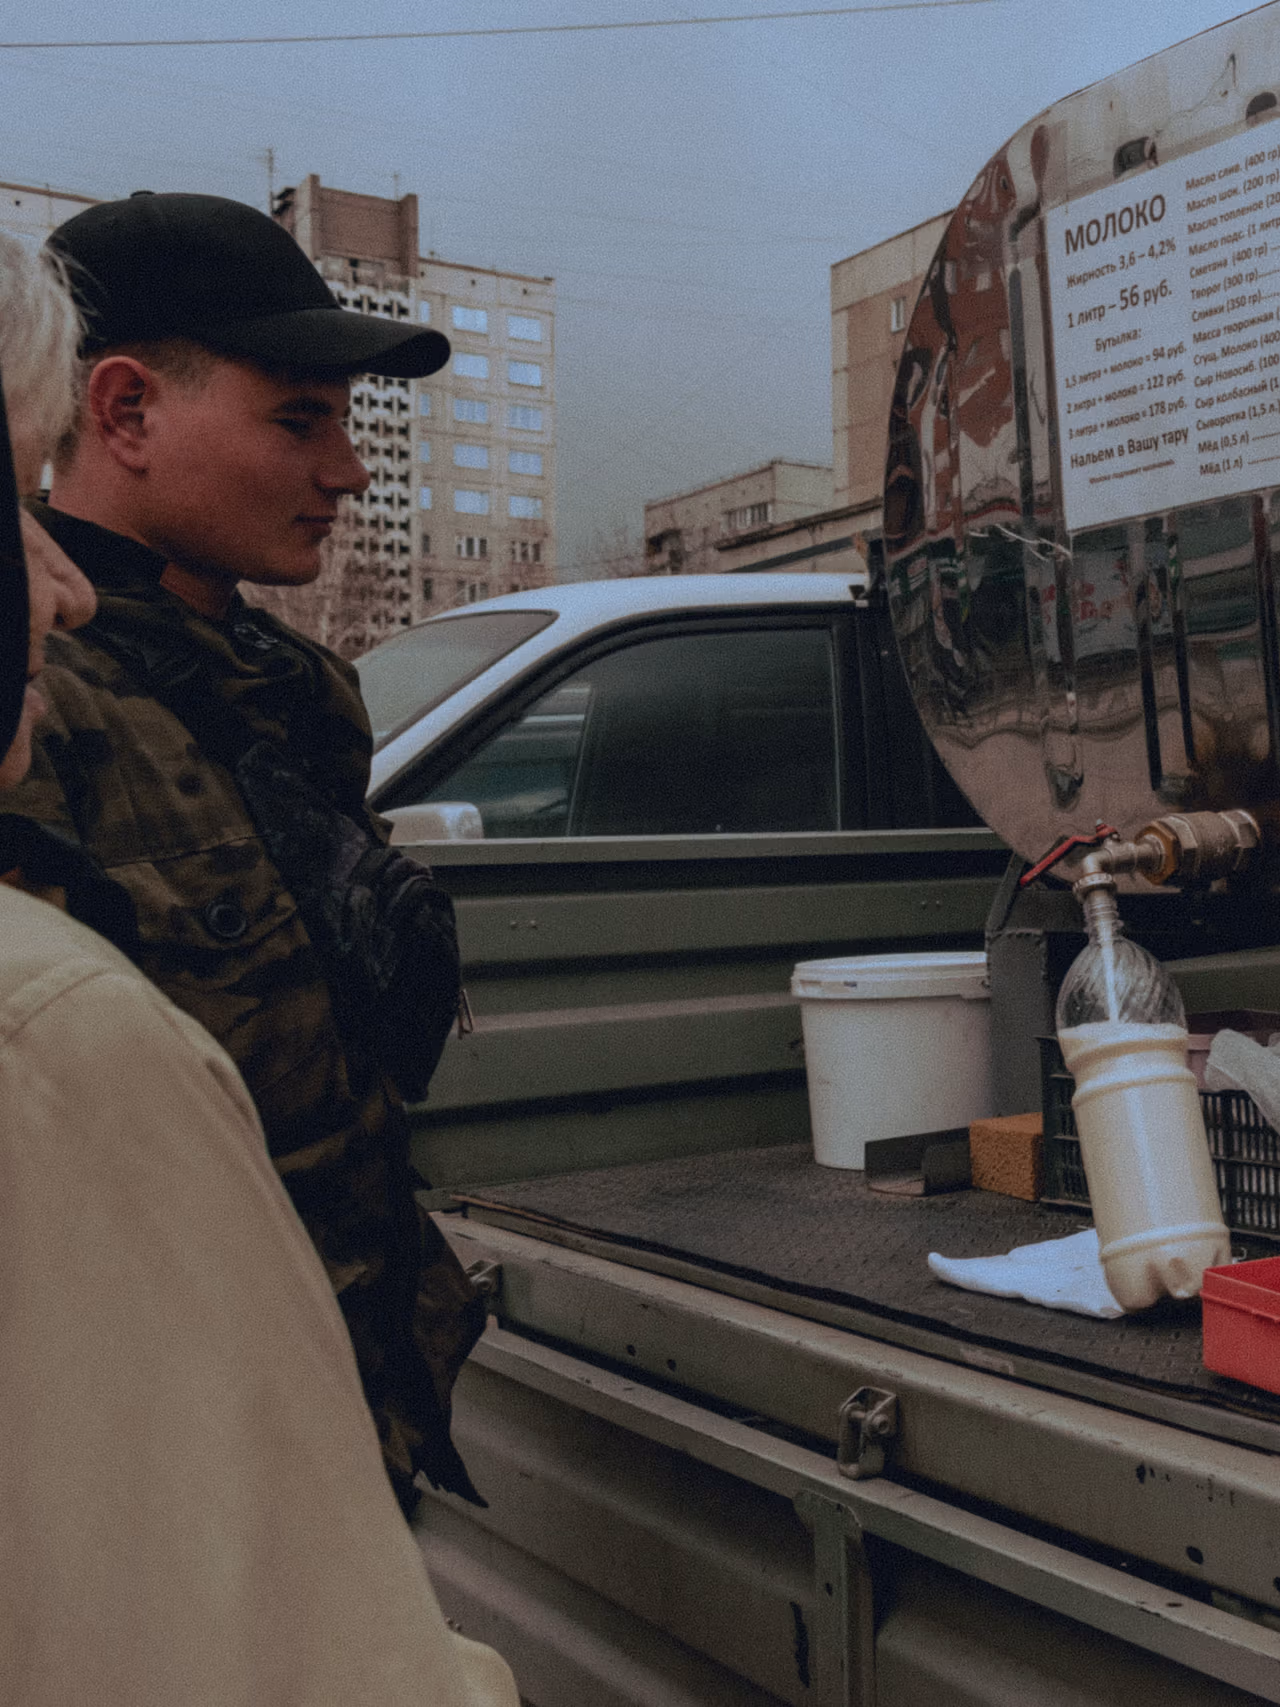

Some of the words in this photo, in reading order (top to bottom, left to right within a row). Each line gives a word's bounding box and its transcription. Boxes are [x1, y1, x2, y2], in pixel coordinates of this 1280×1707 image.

[1185, 173, 1216, 190] Масло
[1244, 151, 1266, 170] (400
[1186, 195, 1217, 212] Масло
[1243, 175, 1264, 194] (200
[1265, 168, 1280, 185] гр)
[1064, 194, 1166, 255] МОЛОКО
[1187, 217, 1218, 234] Масло
[1188, 239, 1219, 256] Масло
[1247, 223, 1257, 238] (1
[1066, 263, 1117, 288] Жирность
[1119, 251, 1136, 270] 3,6
[1147, 239, 1176, 259] 4,2%
[1232, 247, 1252, 266] (400
[1253, 242, 1268, 258] гр)
[1223, 273, 1244, 291] (300
[1245, 268, 1259, 283] гр)
[1067, 312, 1075, 329] 1
[1077, 304, 1106, 325] литр
[1119, 284, 1140, 311] 56
[1143, 278, 1172, 307] руб.
[1226, 295, 1247, 313] (350
[1247, 289, 1262, 305] гр)
[1095, 329, 1140, 352] Бутылка:
[1192, 328, 1221, 344] Масса
[1220, 339, 1258, 358] Молоко
[1260, 330, 1280, 347] (400
[1166, 341, 1186, 359] руб.
[1146, 373, 1164, 391] 122
[1166, 369, 1185, 387] руб.
[1194, 375, 1214, 388] Сыр
[1259, 353, 1280, 371] (100
[1194, 397, 1215, 409] Сыр
[1269, 377, 1280, 392] (1
[1148, 401, 1166, 418] 178
[1167, 396, 1187, 414] руб.
[1248, 403, 1267, 420] (1,5
[1070, 447, 1115, 468] Нальем
[1117, 444, 1126, 457] в
[1127, 436, 1159, 455] Вашу
[1161, 428, 1189, 446] тару
[1220, 433, 1238, 450] (0,5
[1239, 431, 1250, 444] л)
[1222, 458, 1231, 472] (1
[1233, 456, 1243, 469] л)
